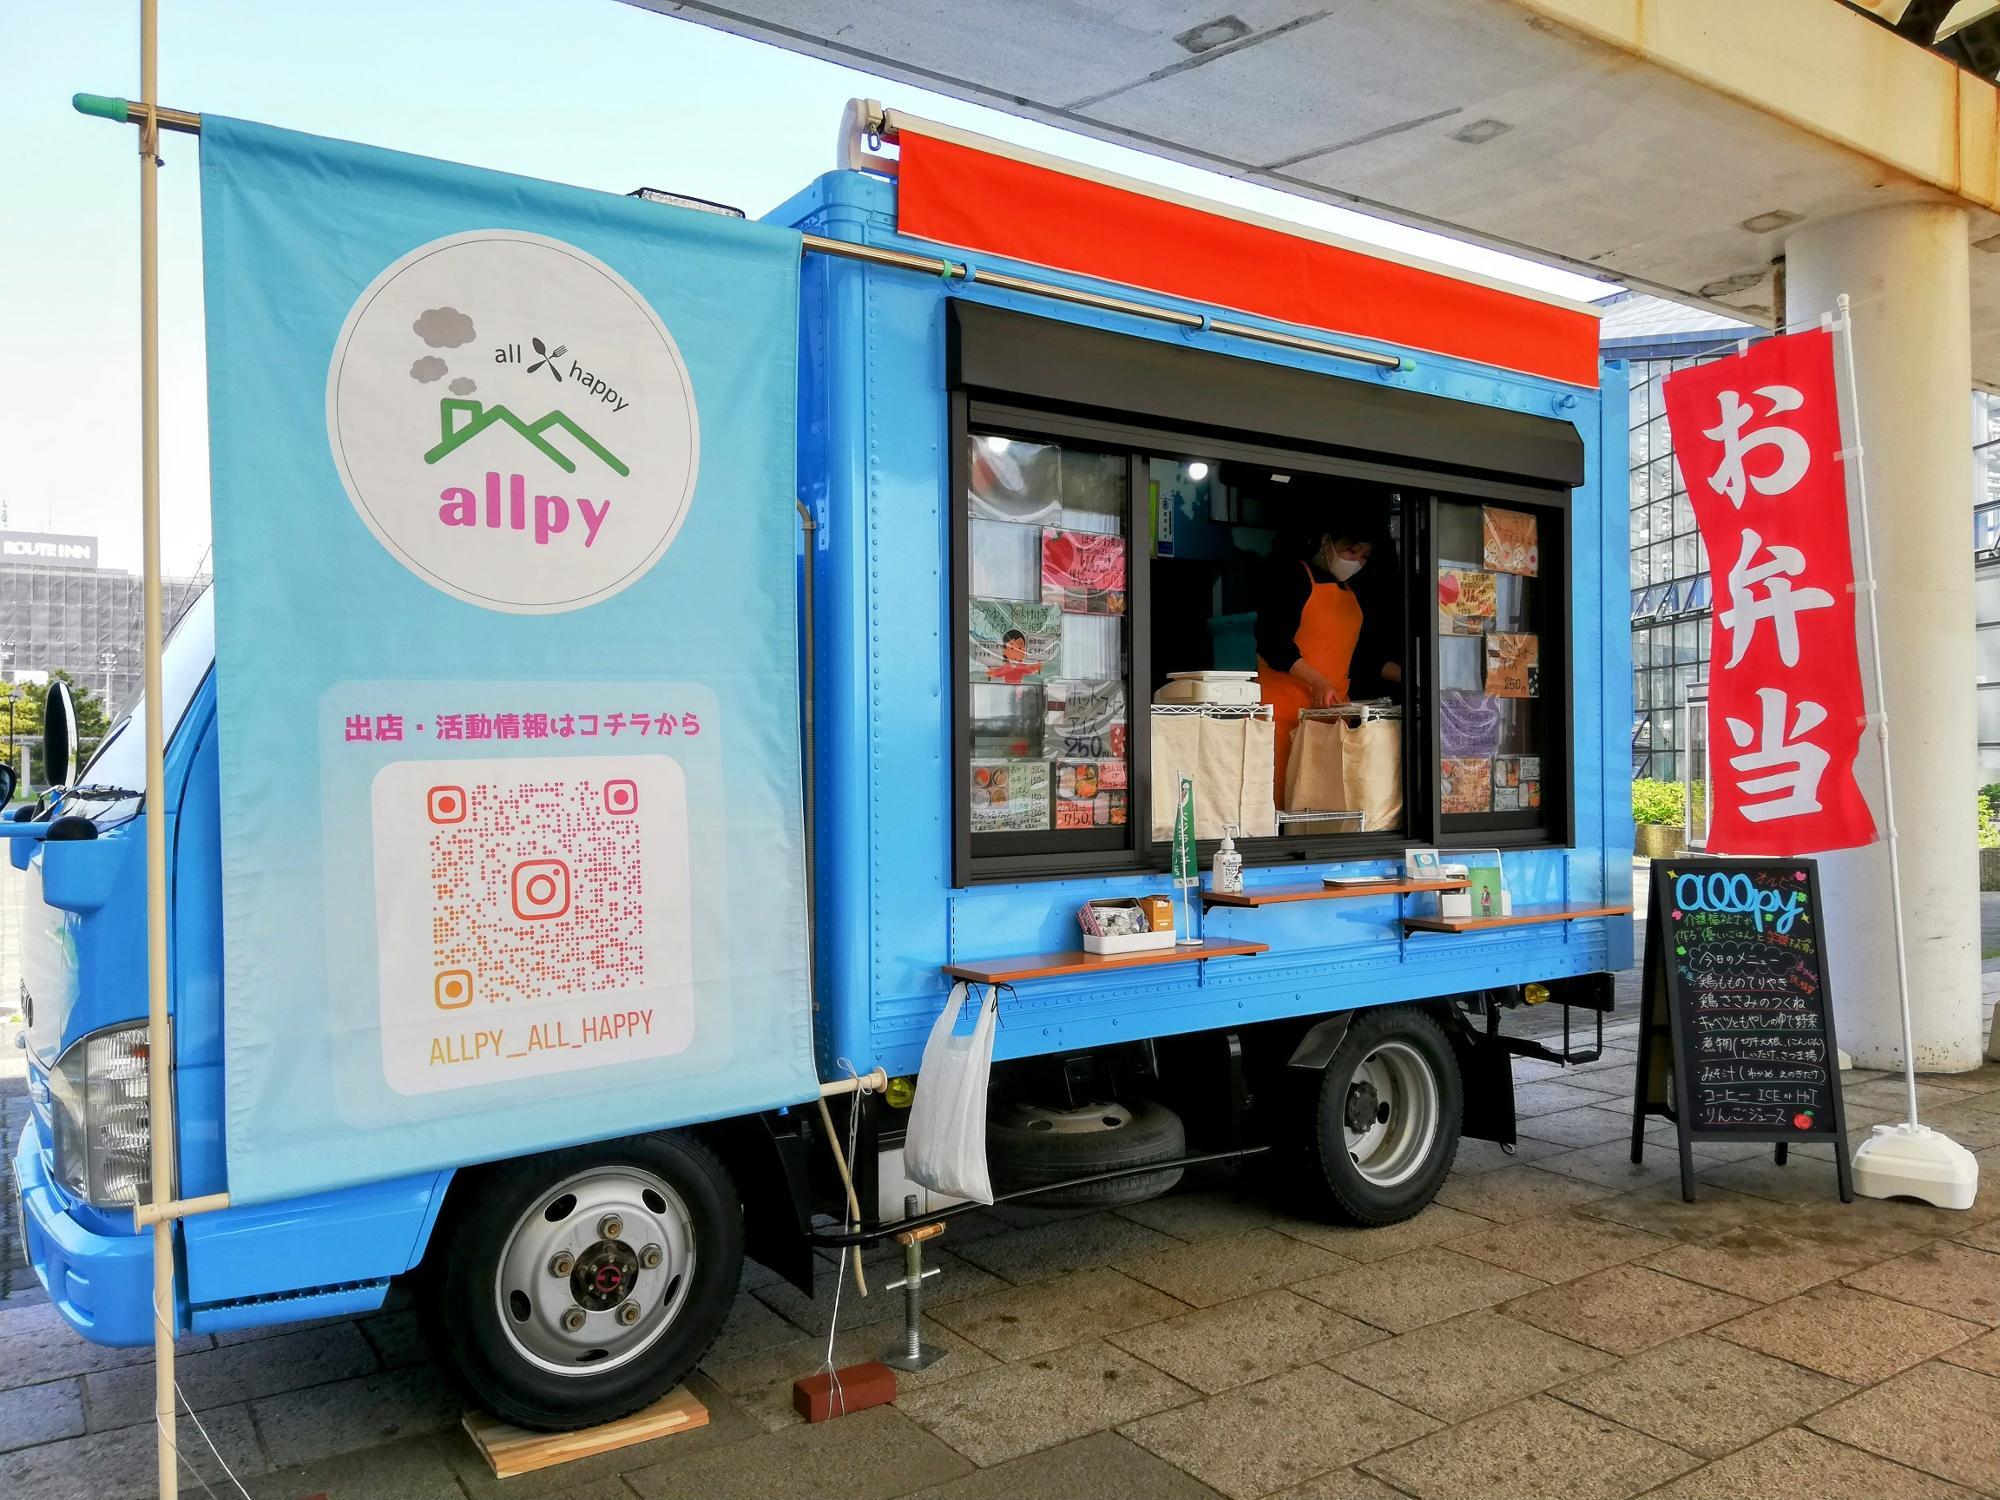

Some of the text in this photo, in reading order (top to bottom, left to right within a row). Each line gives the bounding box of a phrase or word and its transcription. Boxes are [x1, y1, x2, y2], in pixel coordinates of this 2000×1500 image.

[494, 343, 629, 413] all happy
[438, 471, 611, 548] allpy
[1702, 384, 1835, 823] お弁当
[344, 711, 702, 742] 出店・活動情報はコチラから
[1675, 872, 1805, 935] allpy
[1699, 951, 1780, 968] 今日のメニュー
[1703, 1088, 1752, 1102] コーヒー
[1757, 1089, 1782, 1101] ICE
[1706, 1107, 1787, 1124] りんごジュース
